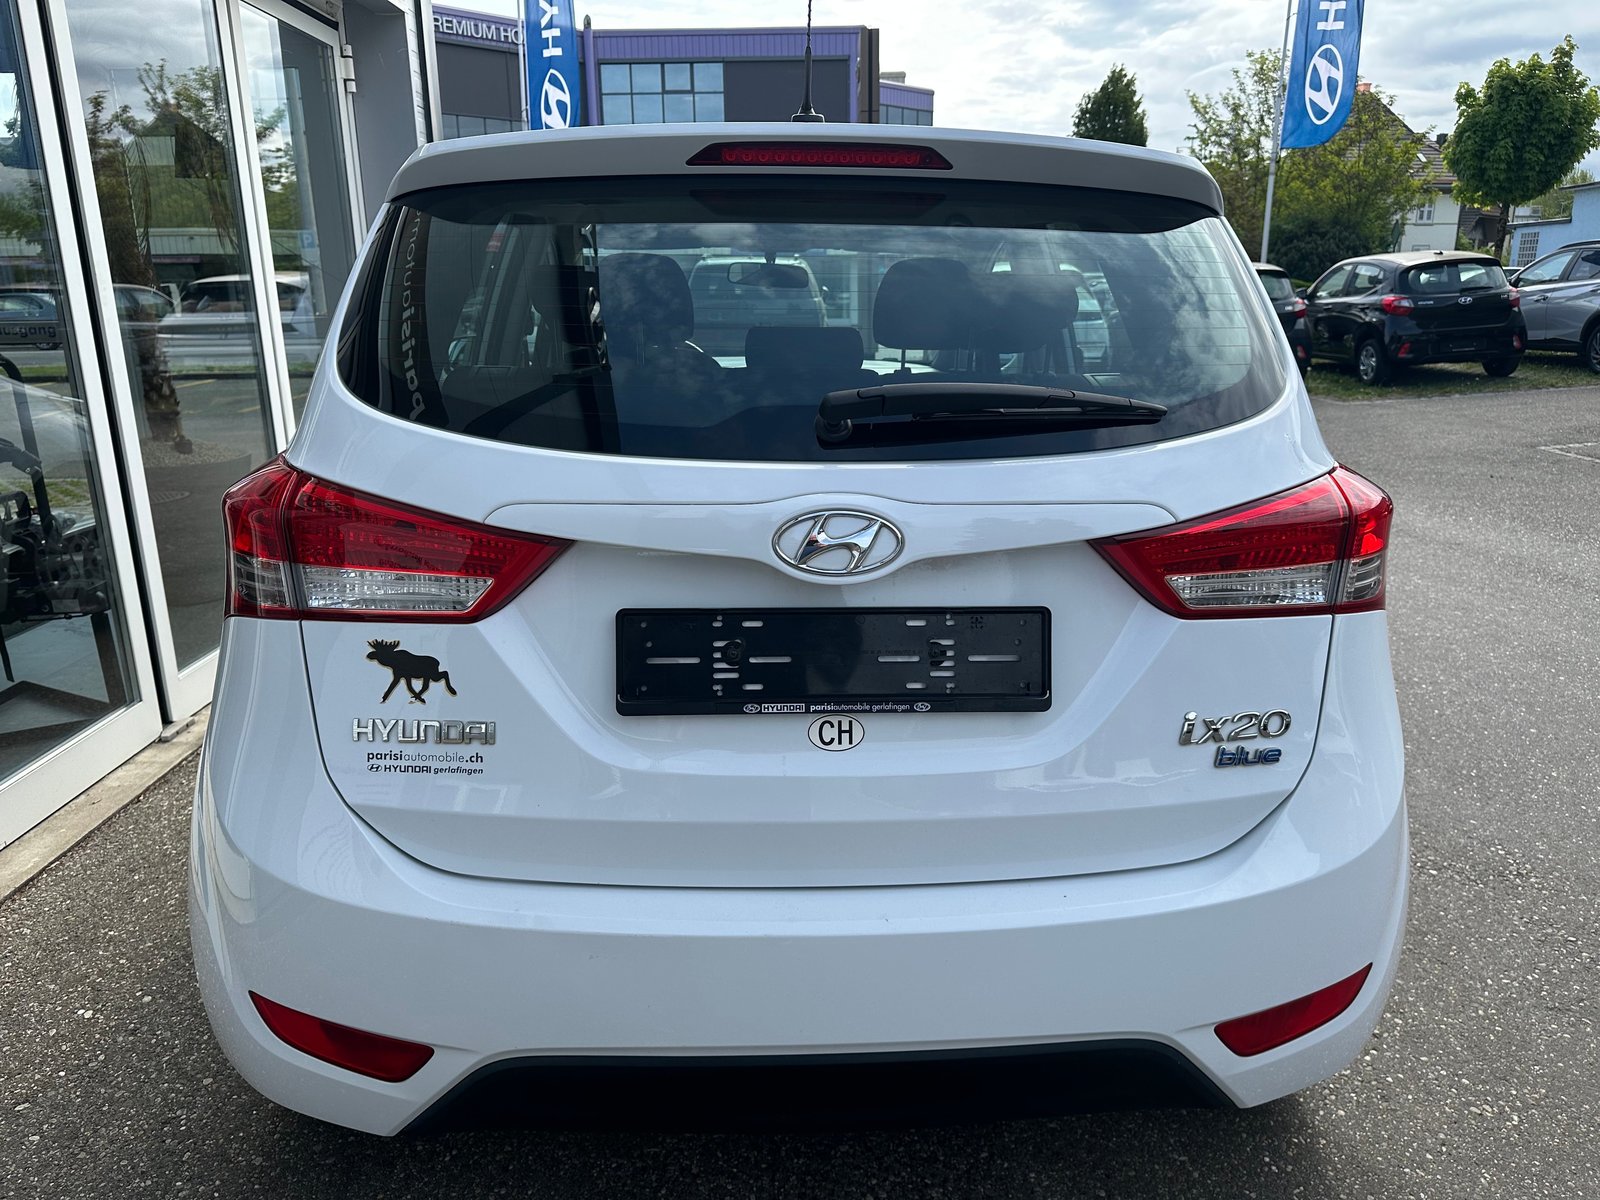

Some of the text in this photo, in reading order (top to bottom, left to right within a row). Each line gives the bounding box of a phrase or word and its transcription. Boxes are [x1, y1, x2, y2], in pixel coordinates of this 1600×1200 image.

[763, 702, 910, 713] HYUNDAI parisiautomobile gerlafingen
[352, 718, 496, 746] HYUNDAI
[818, 719, 853, 746] CH
[1179, 709, 1291, 746] ix20
[367, 750, 484, 763] parisiautomobile.ch
[1214, 745, 1282, 769] blue
[384, 765, 484, 776] HYUNDAI gerlafingen
